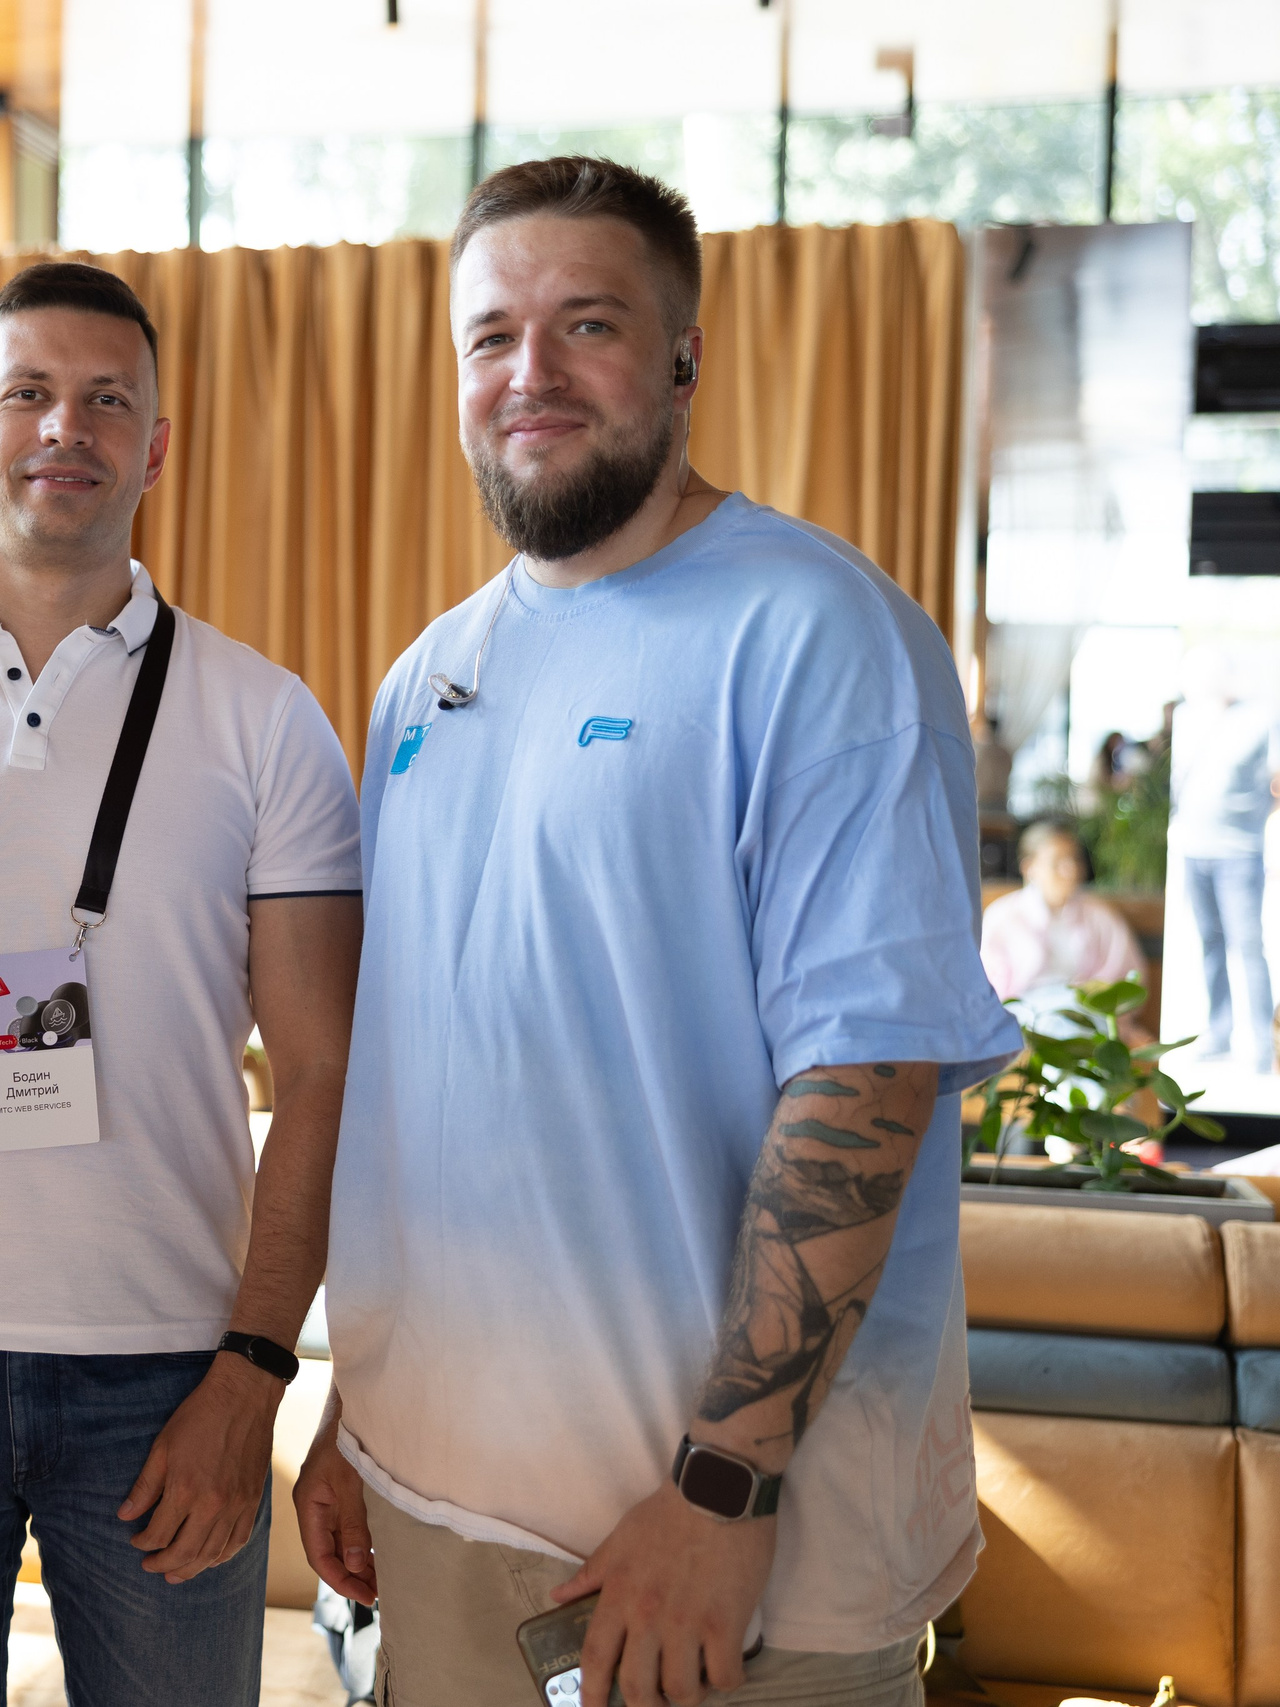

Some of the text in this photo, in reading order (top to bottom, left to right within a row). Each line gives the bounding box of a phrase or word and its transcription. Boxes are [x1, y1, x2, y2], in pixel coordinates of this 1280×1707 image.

[21, 1036, 39, 1044] Black
[12, 1071, 51, 1083] Бодин
[6, 1083, 60, 1100] Дмитрий
[14, 1104, 33, 1113] WEB
[33, 1101, 72, 1111] SERVICES
